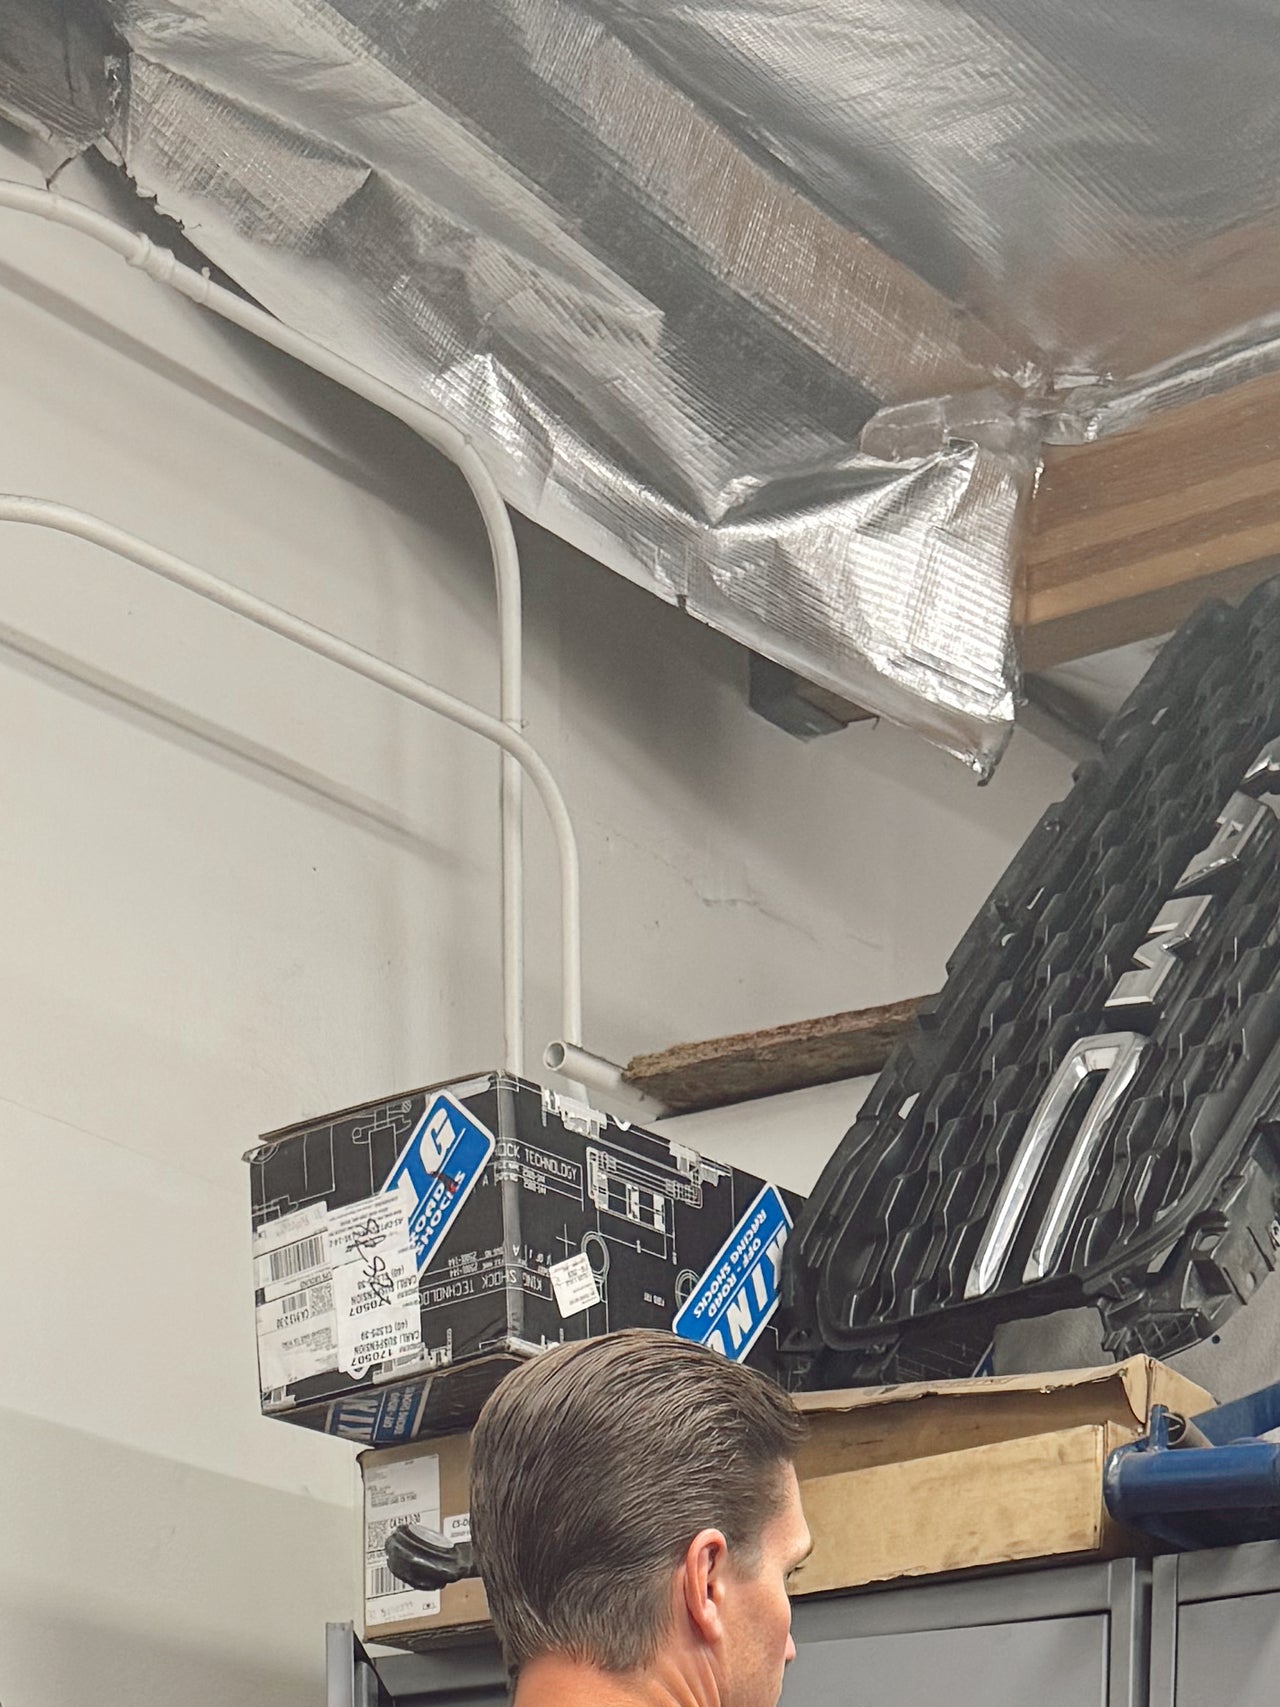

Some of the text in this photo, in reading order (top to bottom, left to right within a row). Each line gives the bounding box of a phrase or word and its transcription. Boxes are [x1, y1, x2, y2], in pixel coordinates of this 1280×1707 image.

[525, 1148, 579, 1181] TECHNOLOGY
[693, 1209, 767, 1318] RACING SHOCKS
[419, 1270, 543, 1306] KING SHOCK TECHNOLO
[708, 1274, 737, 1318] ROAD
[351, 1349, 392, 1366] 170507
[354, 1336, 397, 1354] SUSPENSION
